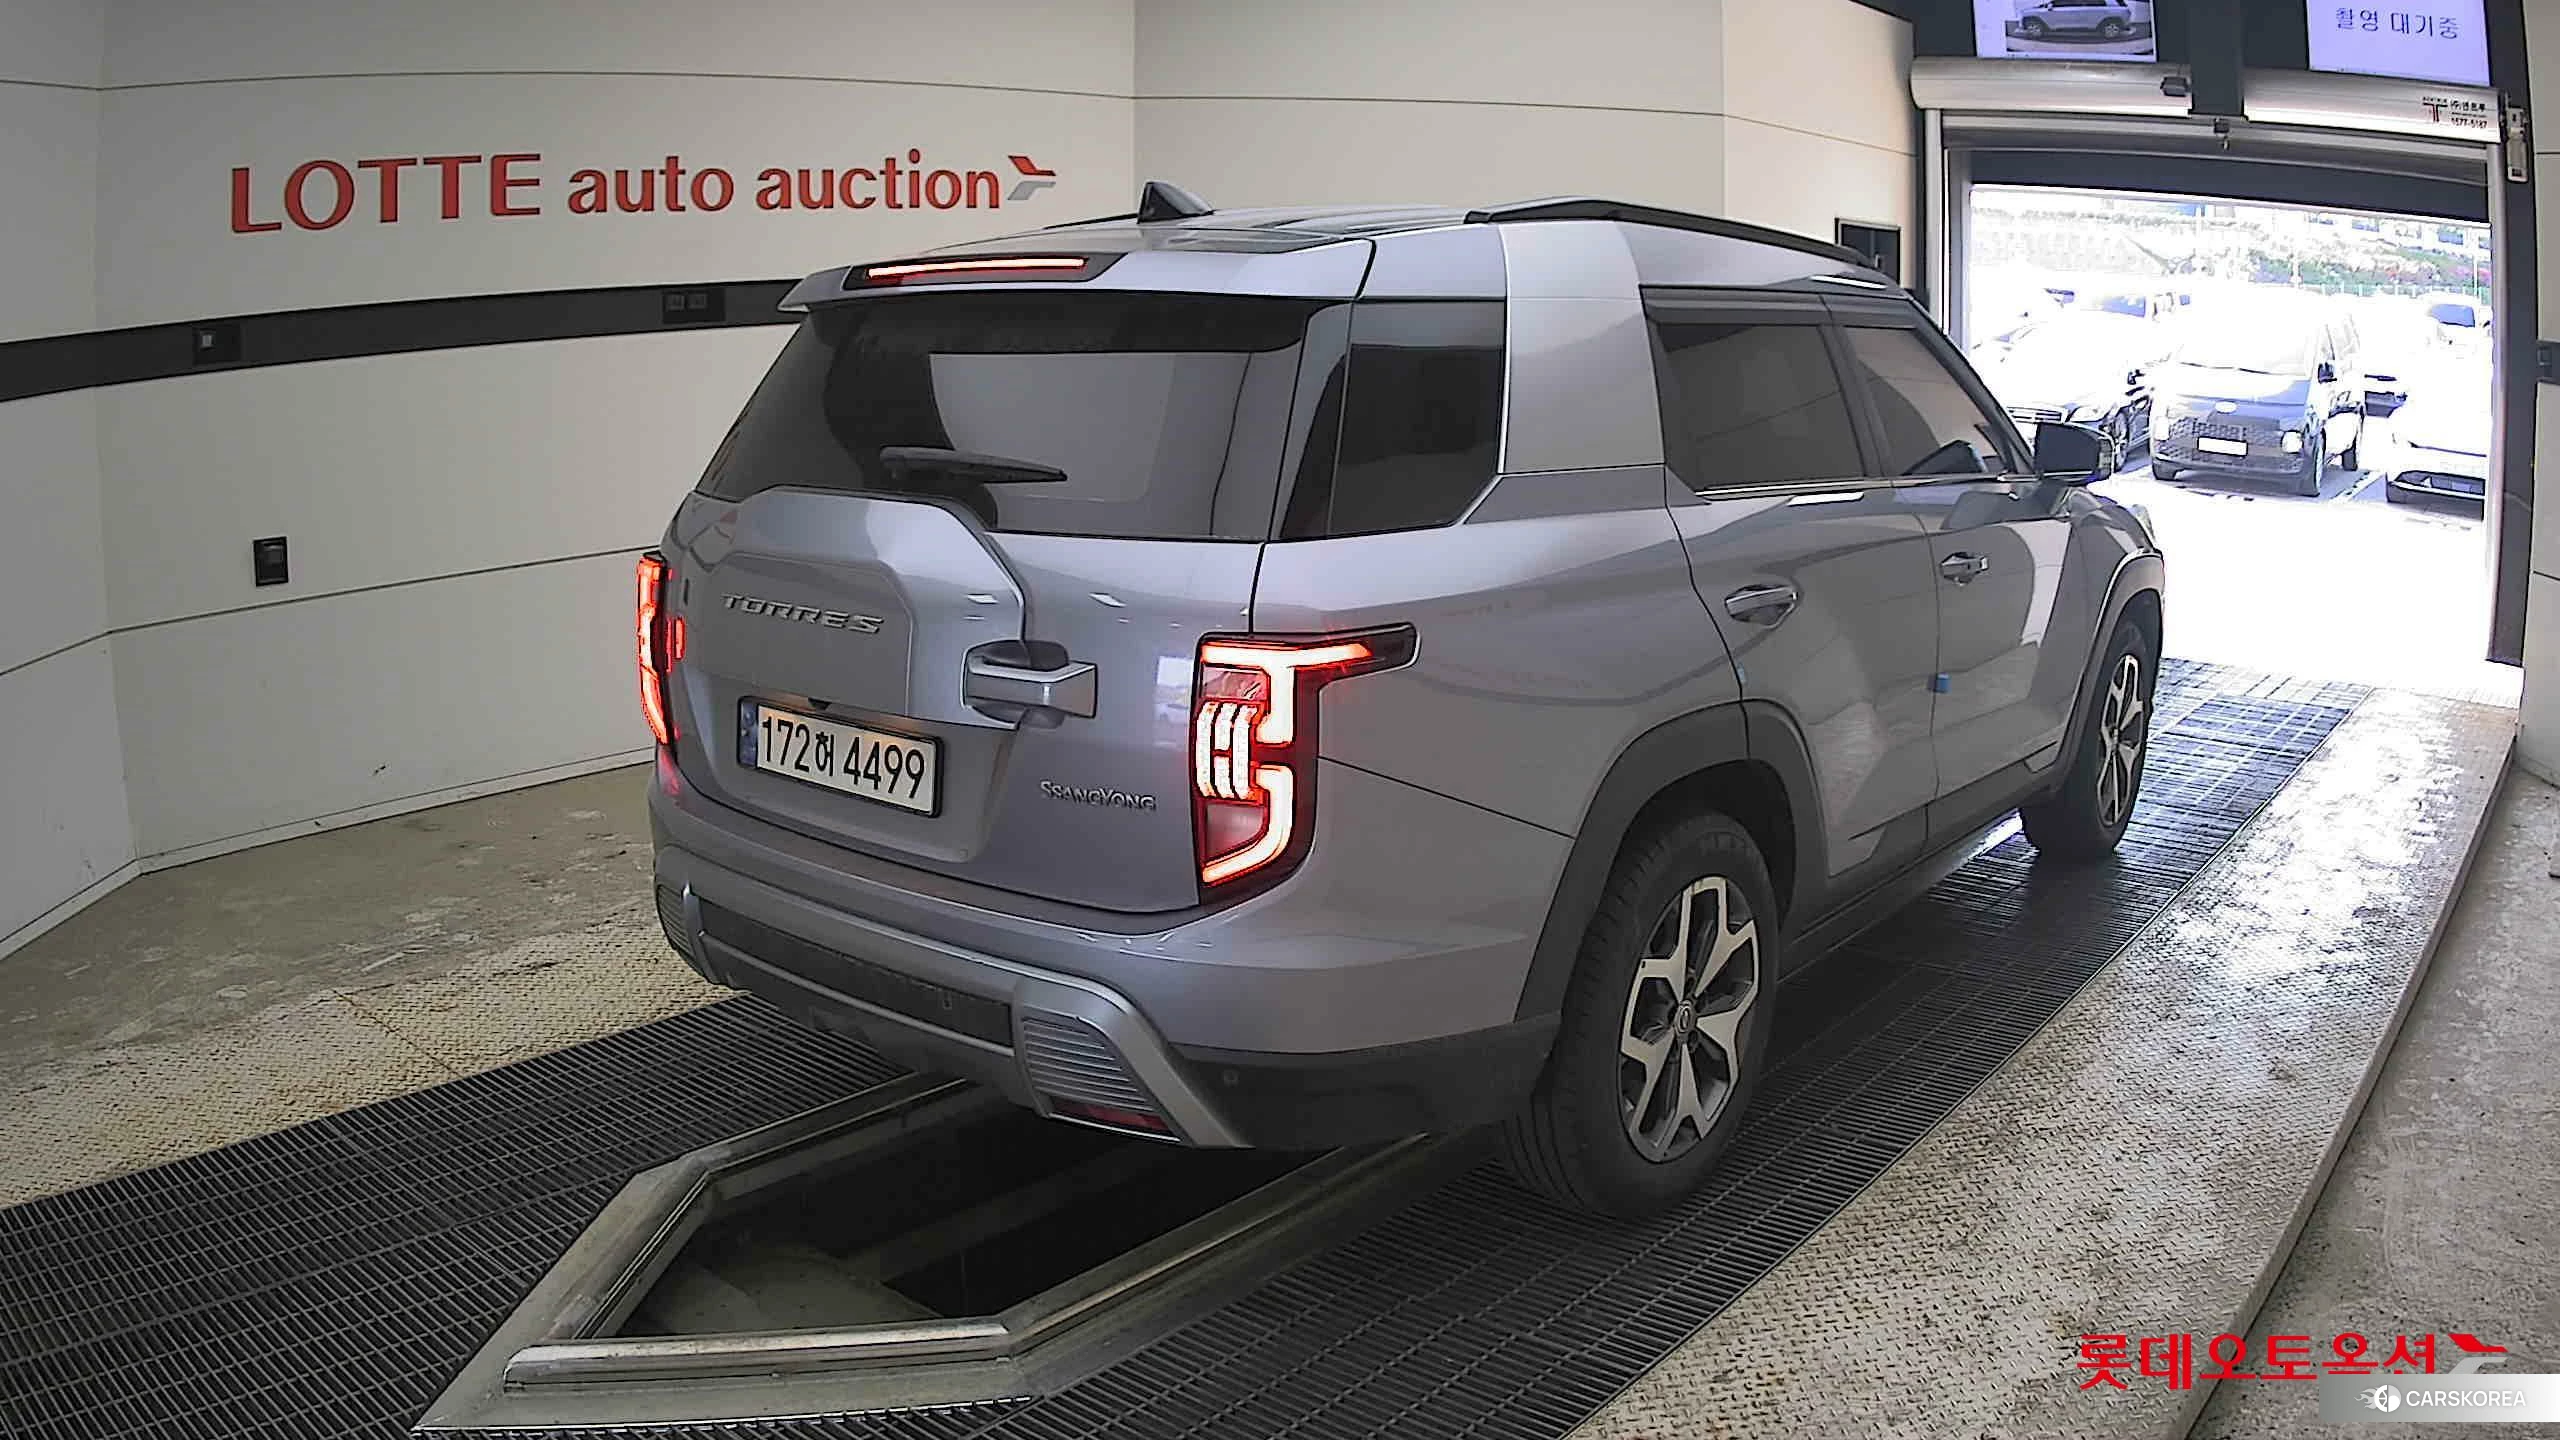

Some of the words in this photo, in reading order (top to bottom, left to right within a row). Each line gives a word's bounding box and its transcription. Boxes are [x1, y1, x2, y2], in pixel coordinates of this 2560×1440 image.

[2335, 7, 2379, 32] 촬영
[2390, 12, 2460, 40] 대기중
[231, 154, 541, 234] LOTTE
[567, 155, 735, 214] auto
[756, 149, 1001, 211] auction
[721, 592, 885, 634] TORRES
[762, 715, 835, 778] 172허
[843, 736, 926, 799] 4499
